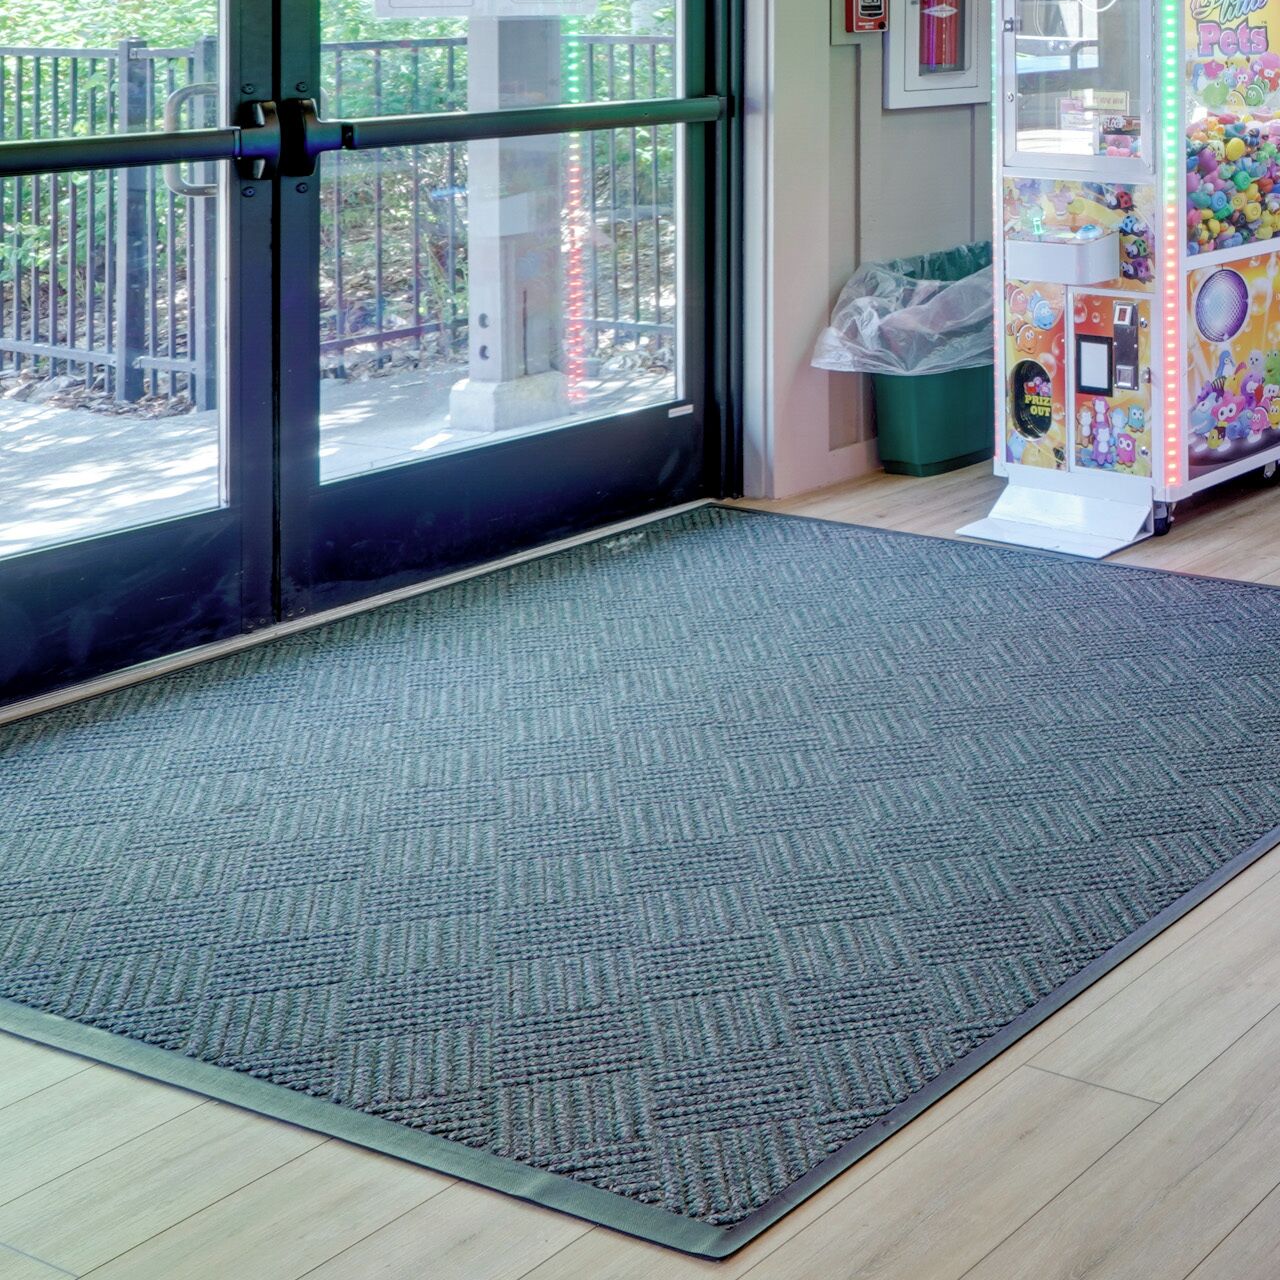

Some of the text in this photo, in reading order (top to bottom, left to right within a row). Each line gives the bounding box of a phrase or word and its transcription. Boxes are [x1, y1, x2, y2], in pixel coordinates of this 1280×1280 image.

[1196, 20, 1270, 57] Pets
[1024, 395, 1051, 406] PRIZ
[1030, 405, 1051, 417] OUT
